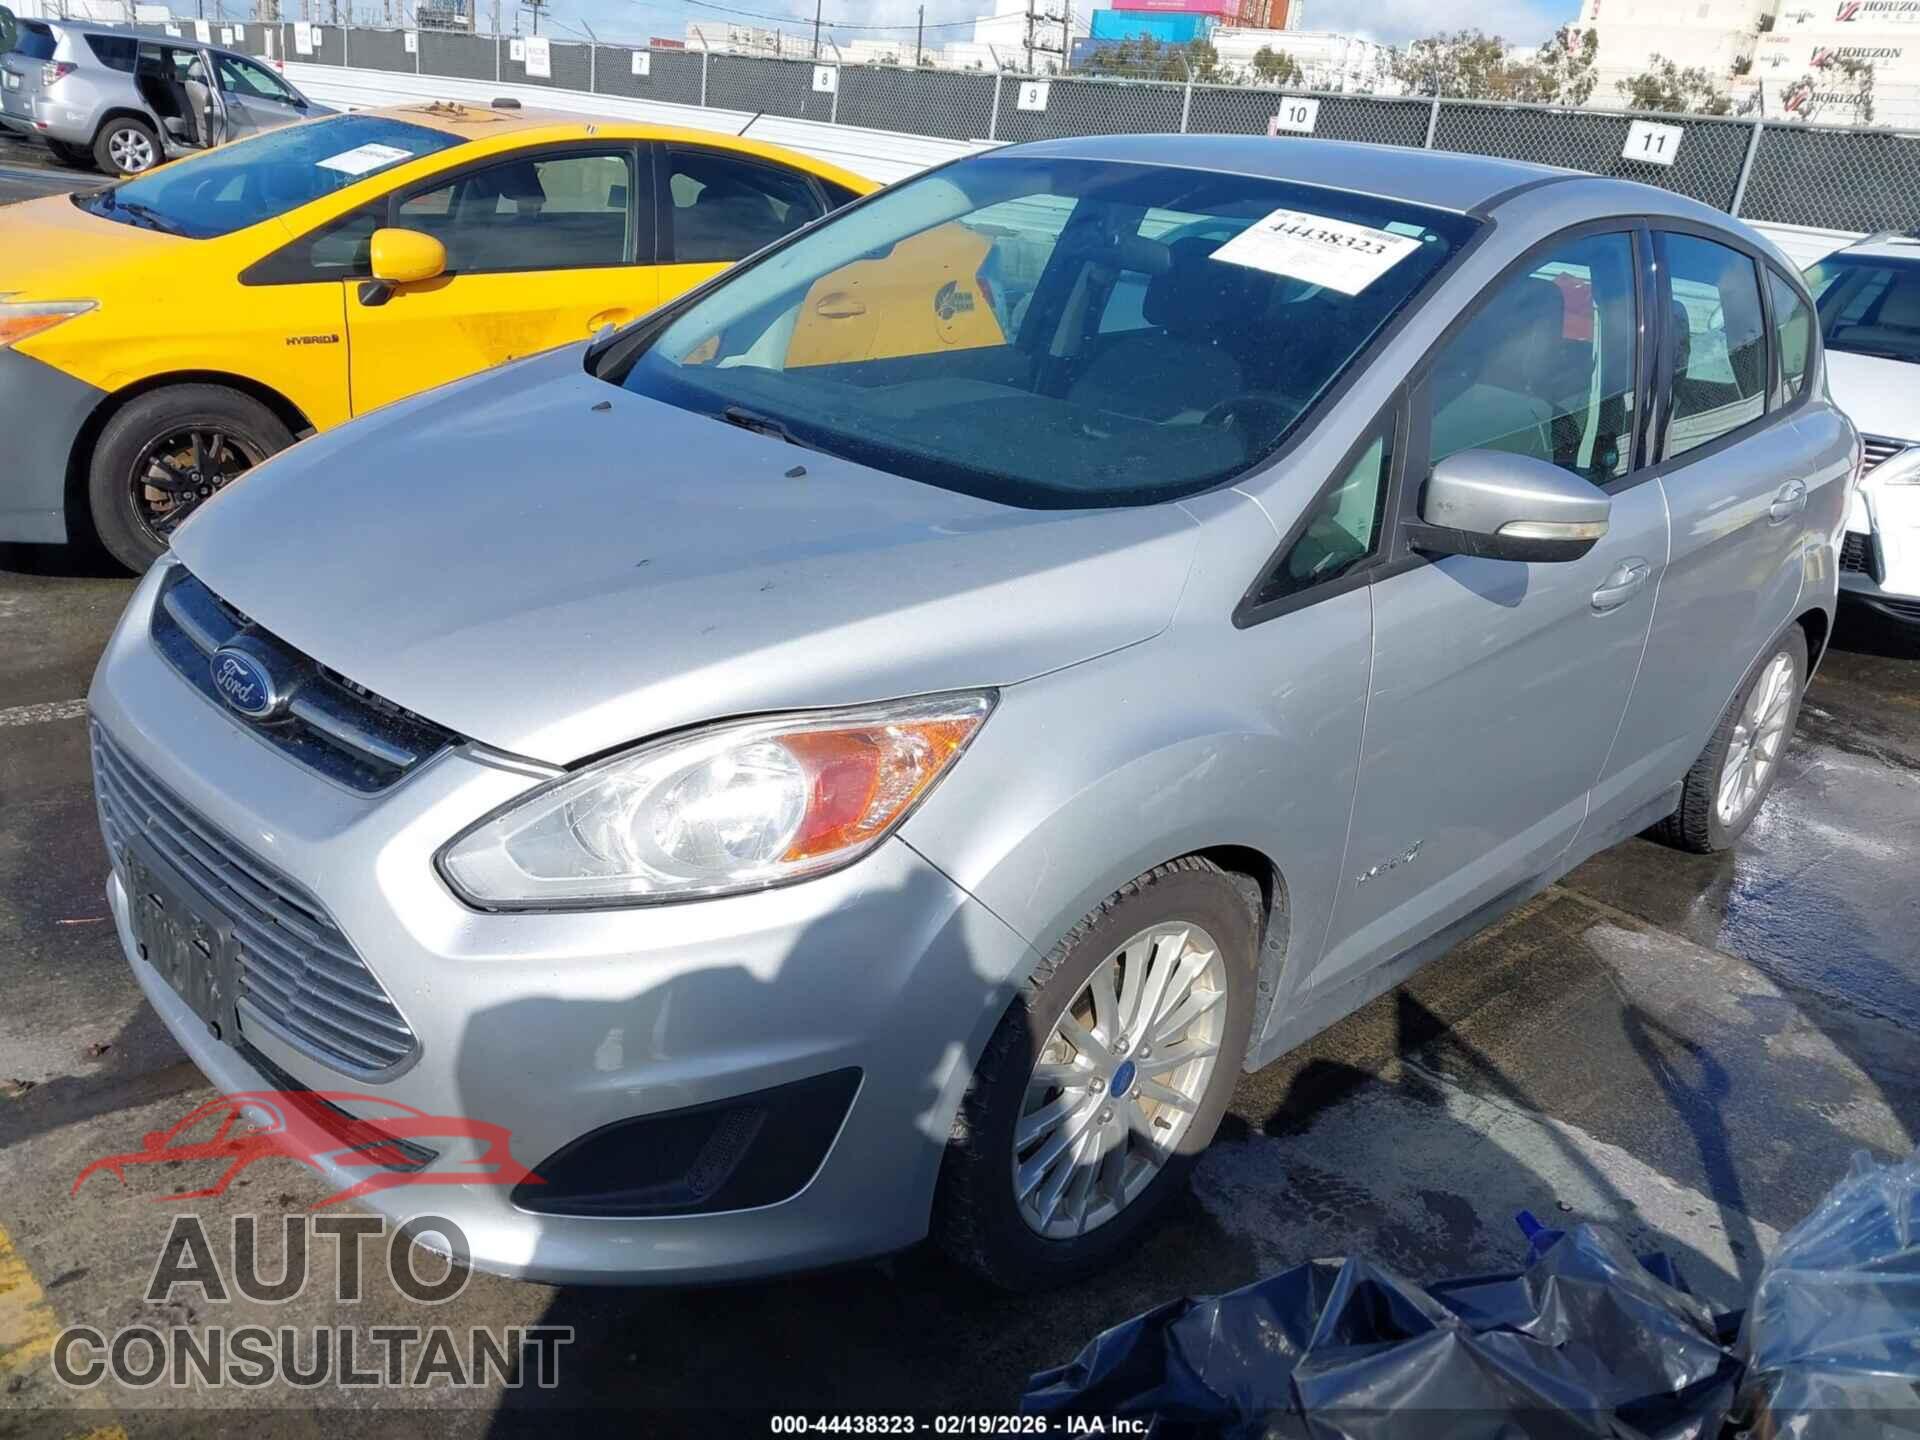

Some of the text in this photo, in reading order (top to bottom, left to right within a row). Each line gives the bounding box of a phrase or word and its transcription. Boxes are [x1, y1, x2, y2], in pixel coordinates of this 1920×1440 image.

[1837, 47, 1903, 58] HORIZON
[821, 73, 828, 86] 8
[1029, 89, 1037, 103] 9
[1810, 92, 1873, 105] HORIZON
[1289, 106, 1307, 123] 10
[1642, 132, 1666, 153] 11
[1268, 222, 1387, 255] 44438323
[286, 335, 331, 345] HYBRID
[216, 658, 256, 702] Ford
